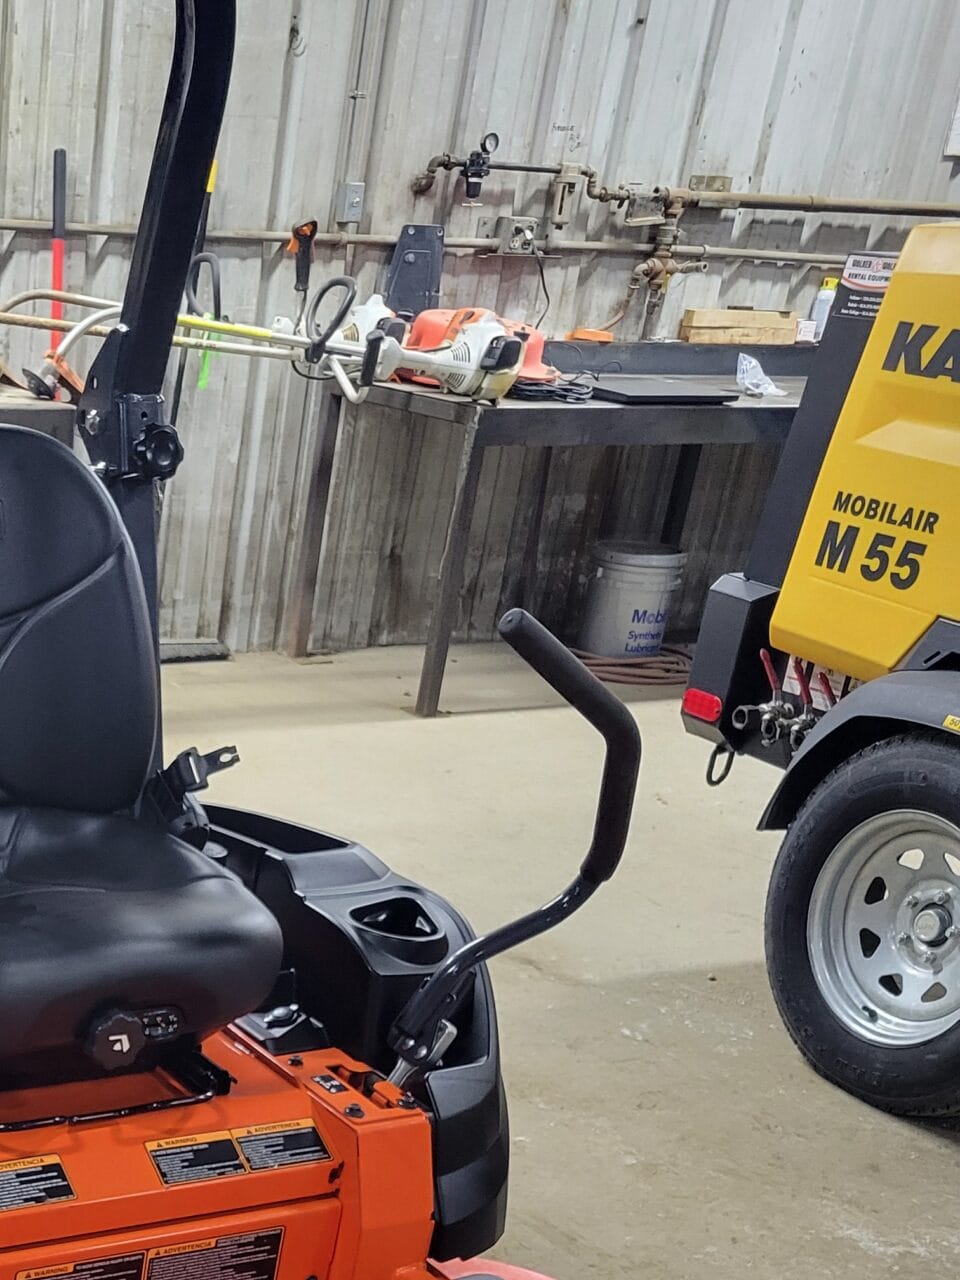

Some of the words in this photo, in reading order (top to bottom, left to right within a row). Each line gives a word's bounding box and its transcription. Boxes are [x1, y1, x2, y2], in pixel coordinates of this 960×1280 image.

[848, 272, 867, 280] RENTAL
[868, 274, 891, 282] EQUIPM
[881, 321, 960, 379] KA
[833, 491, 940, 535] MOBILAIR
[814, 521, 860, 575] M
[860, 534, 928, 591] 55
[631, 609, 669, 625] Mobi
[627, 630, 662, 642] Synthet
[254, 1121, 302, 1134] ADVERTENCIA
[163, 1136, 197, 1149] WARNING
[163, 1240, 214, 1256] ADVERTENCIA
[33, 1265, 69, 1279] WARNING
